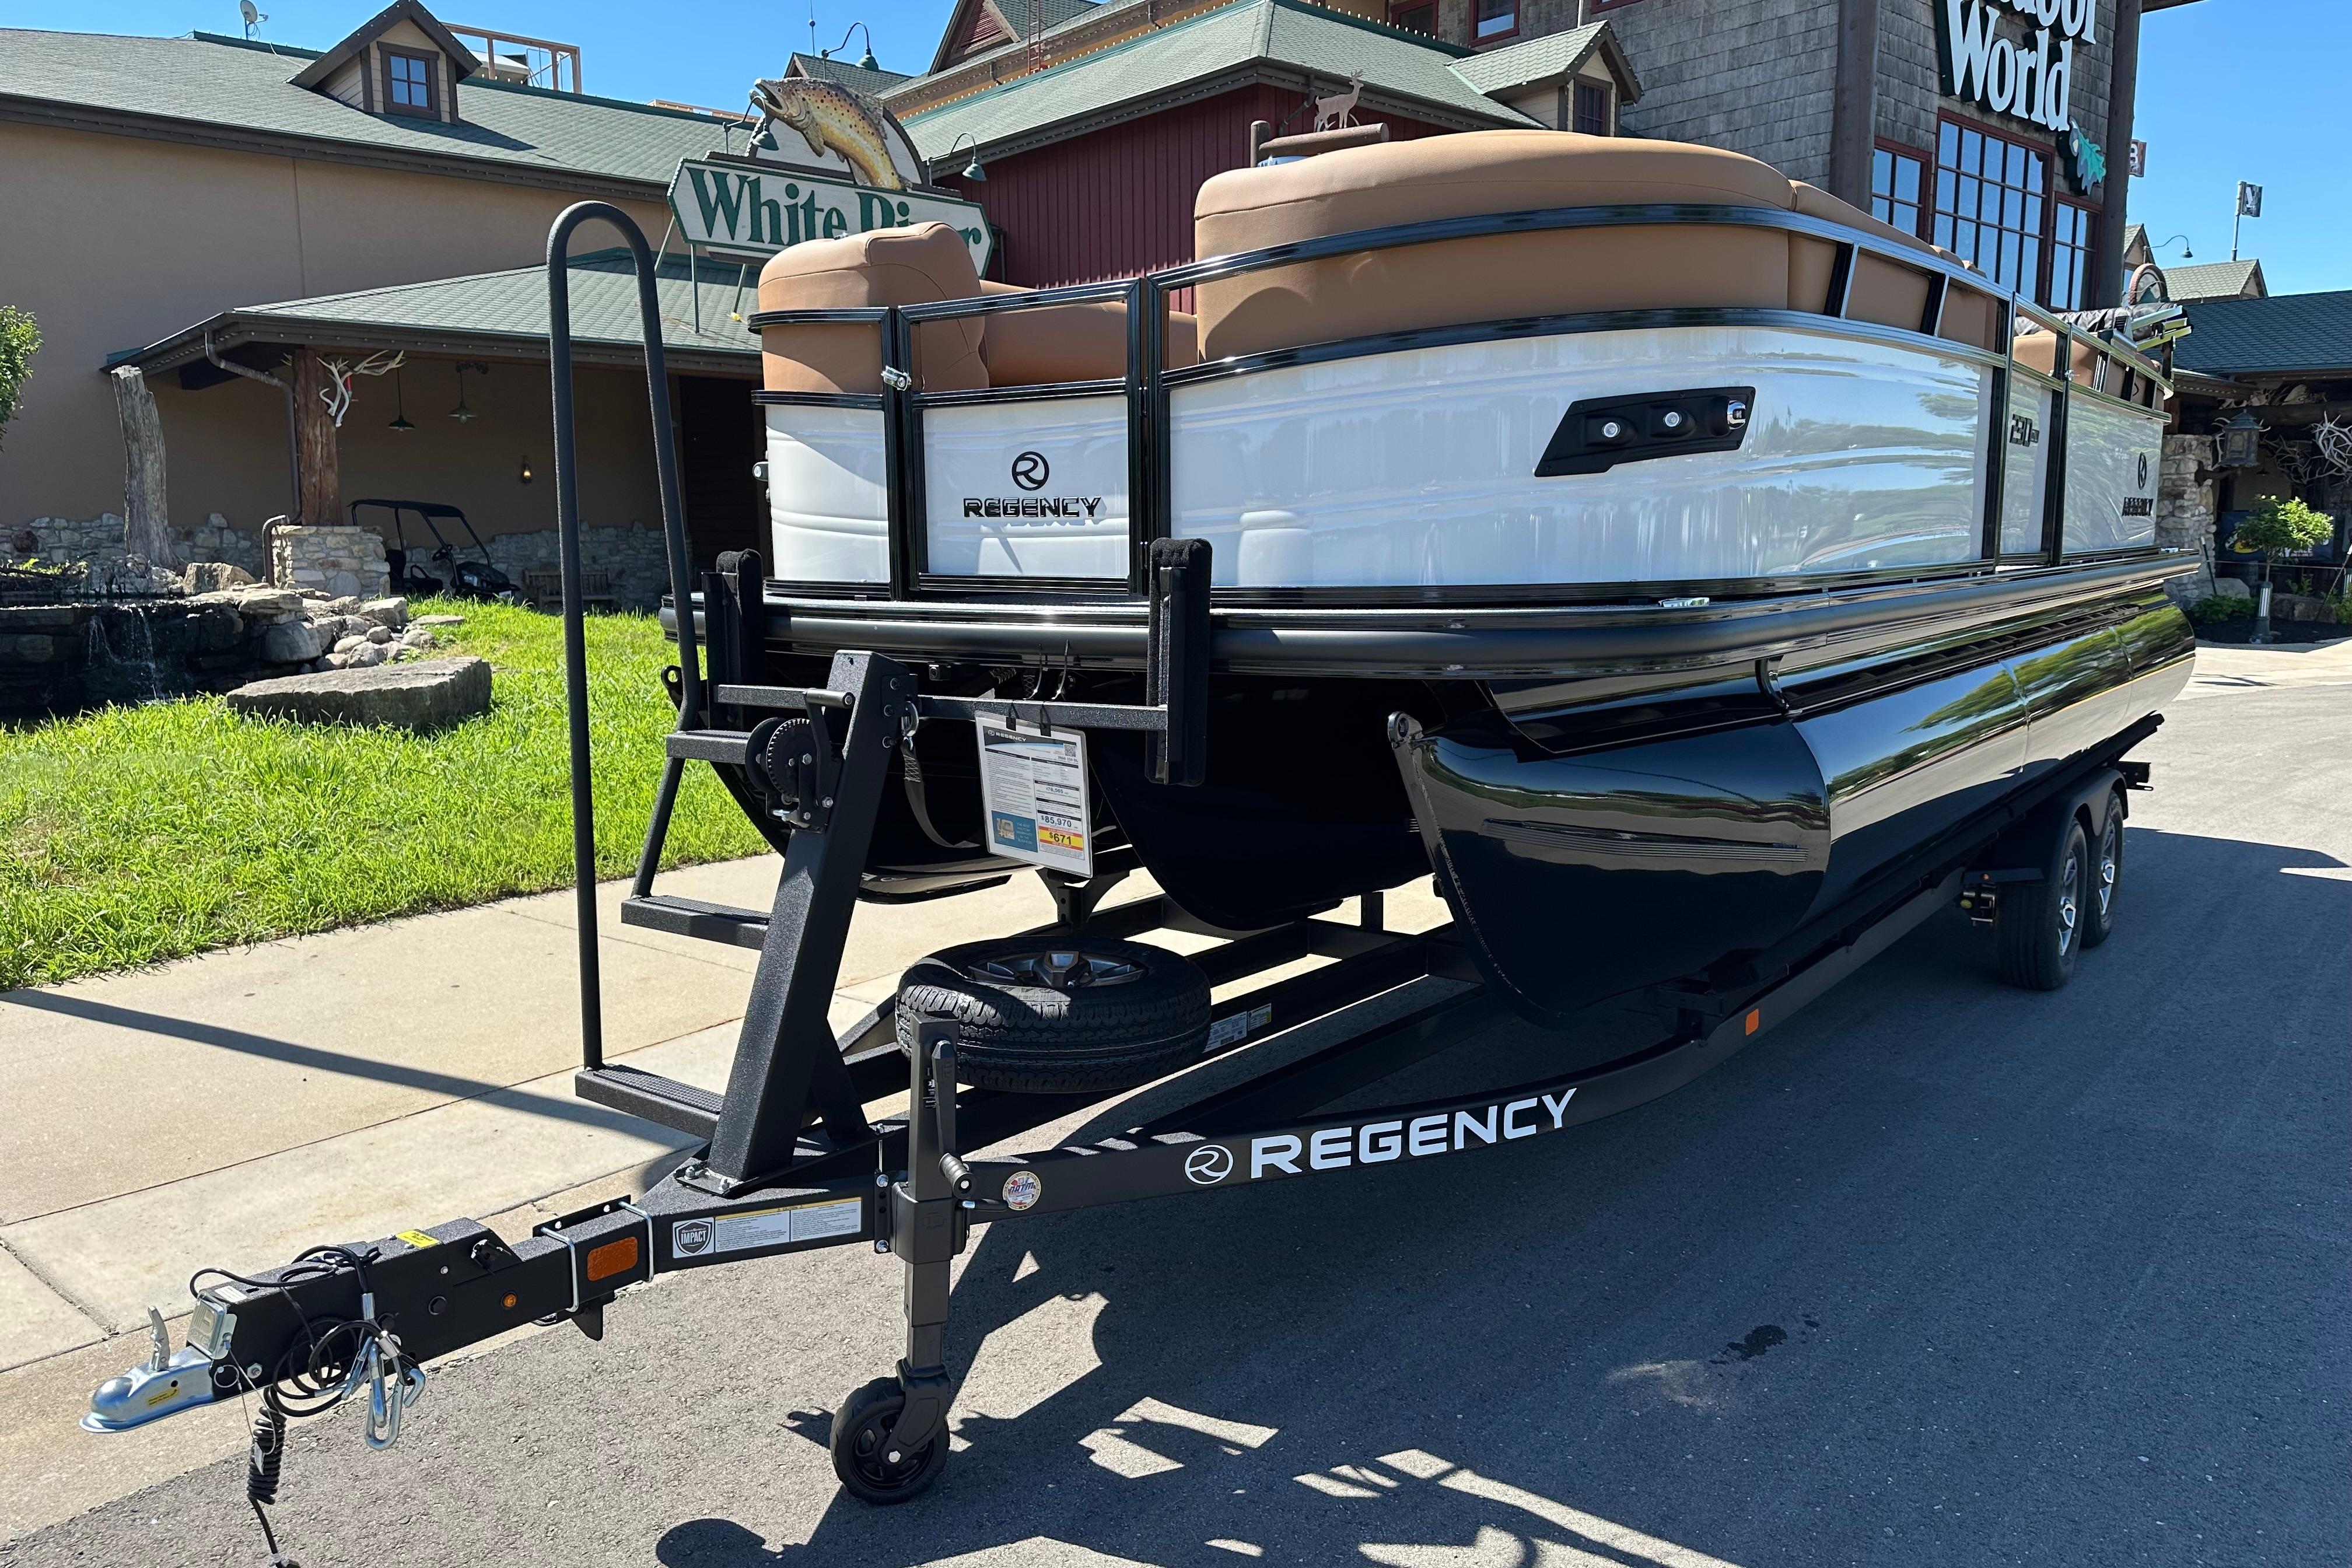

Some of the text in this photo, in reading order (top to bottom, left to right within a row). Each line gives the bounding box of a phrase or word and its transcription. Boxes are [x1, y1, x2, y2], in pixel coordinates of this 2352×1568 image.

[1947, 0, 2073, 132] World
[688, 167, 848, 246] White
[963, 495, 1101, 518] REGENCY
[995, 732, 1027, 742] REGENCY
[1041, 815, 1072, 827] $85,970
[1049, 832, 1072, 845] $671
[1250, 1087, 1577, 1180] REGENCY
[681, 1230, 707, 1245] IMPACT
